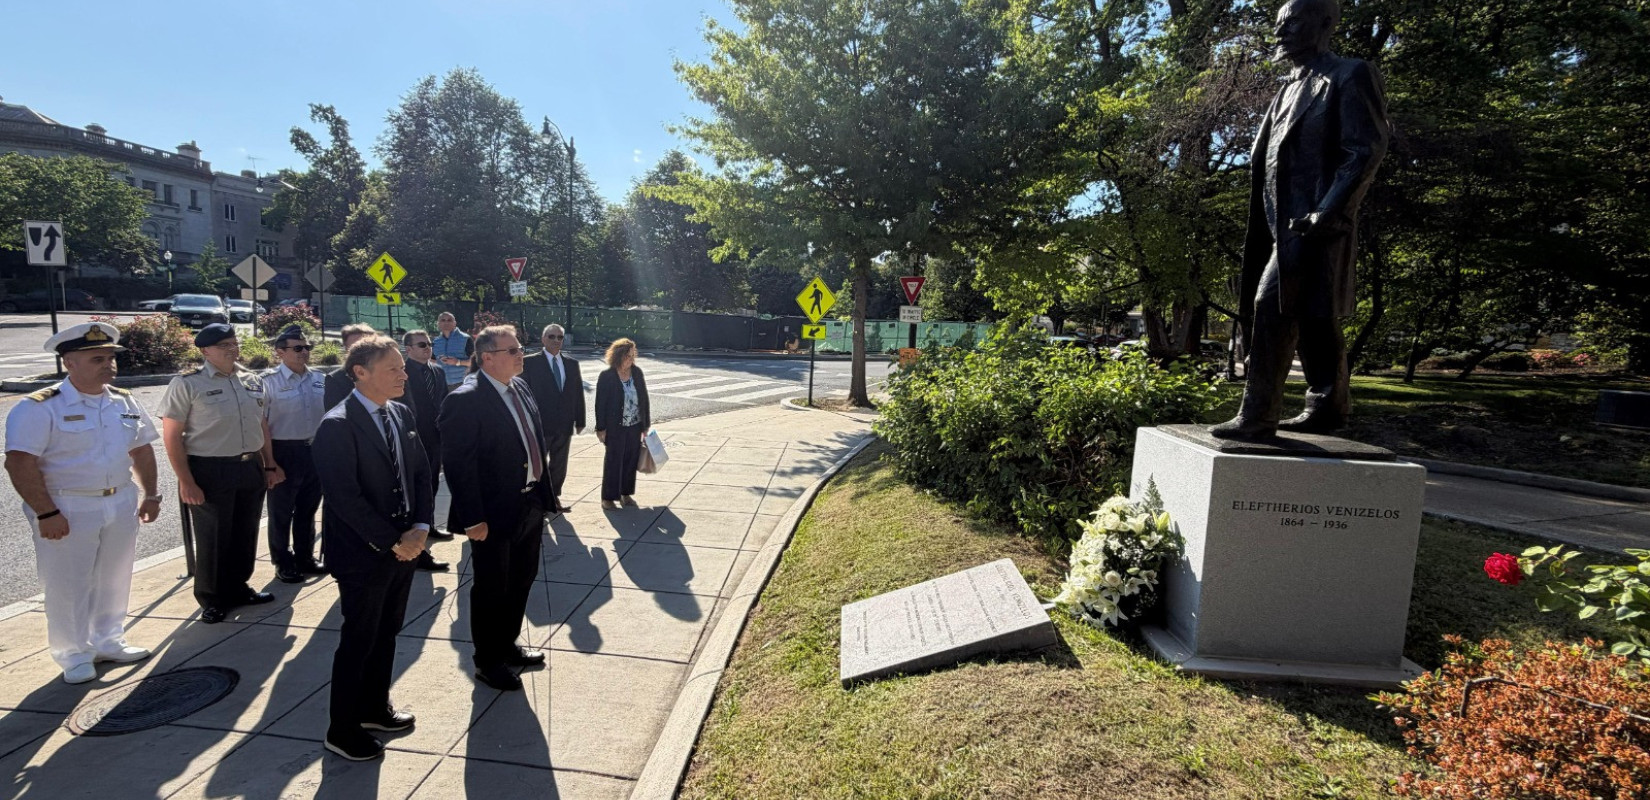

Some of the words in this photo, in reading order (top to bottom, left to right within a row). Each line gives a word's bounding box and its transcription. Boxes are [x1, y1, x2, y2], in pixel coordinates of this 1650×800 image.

[1232, 500, 1320, 515] ELEFTHERIOS
[1326, 506, 1400, 519] VENIZELOS
[1280, 517, 1304, 527] 1864
[1323, 520, 1348, 530] 1936
